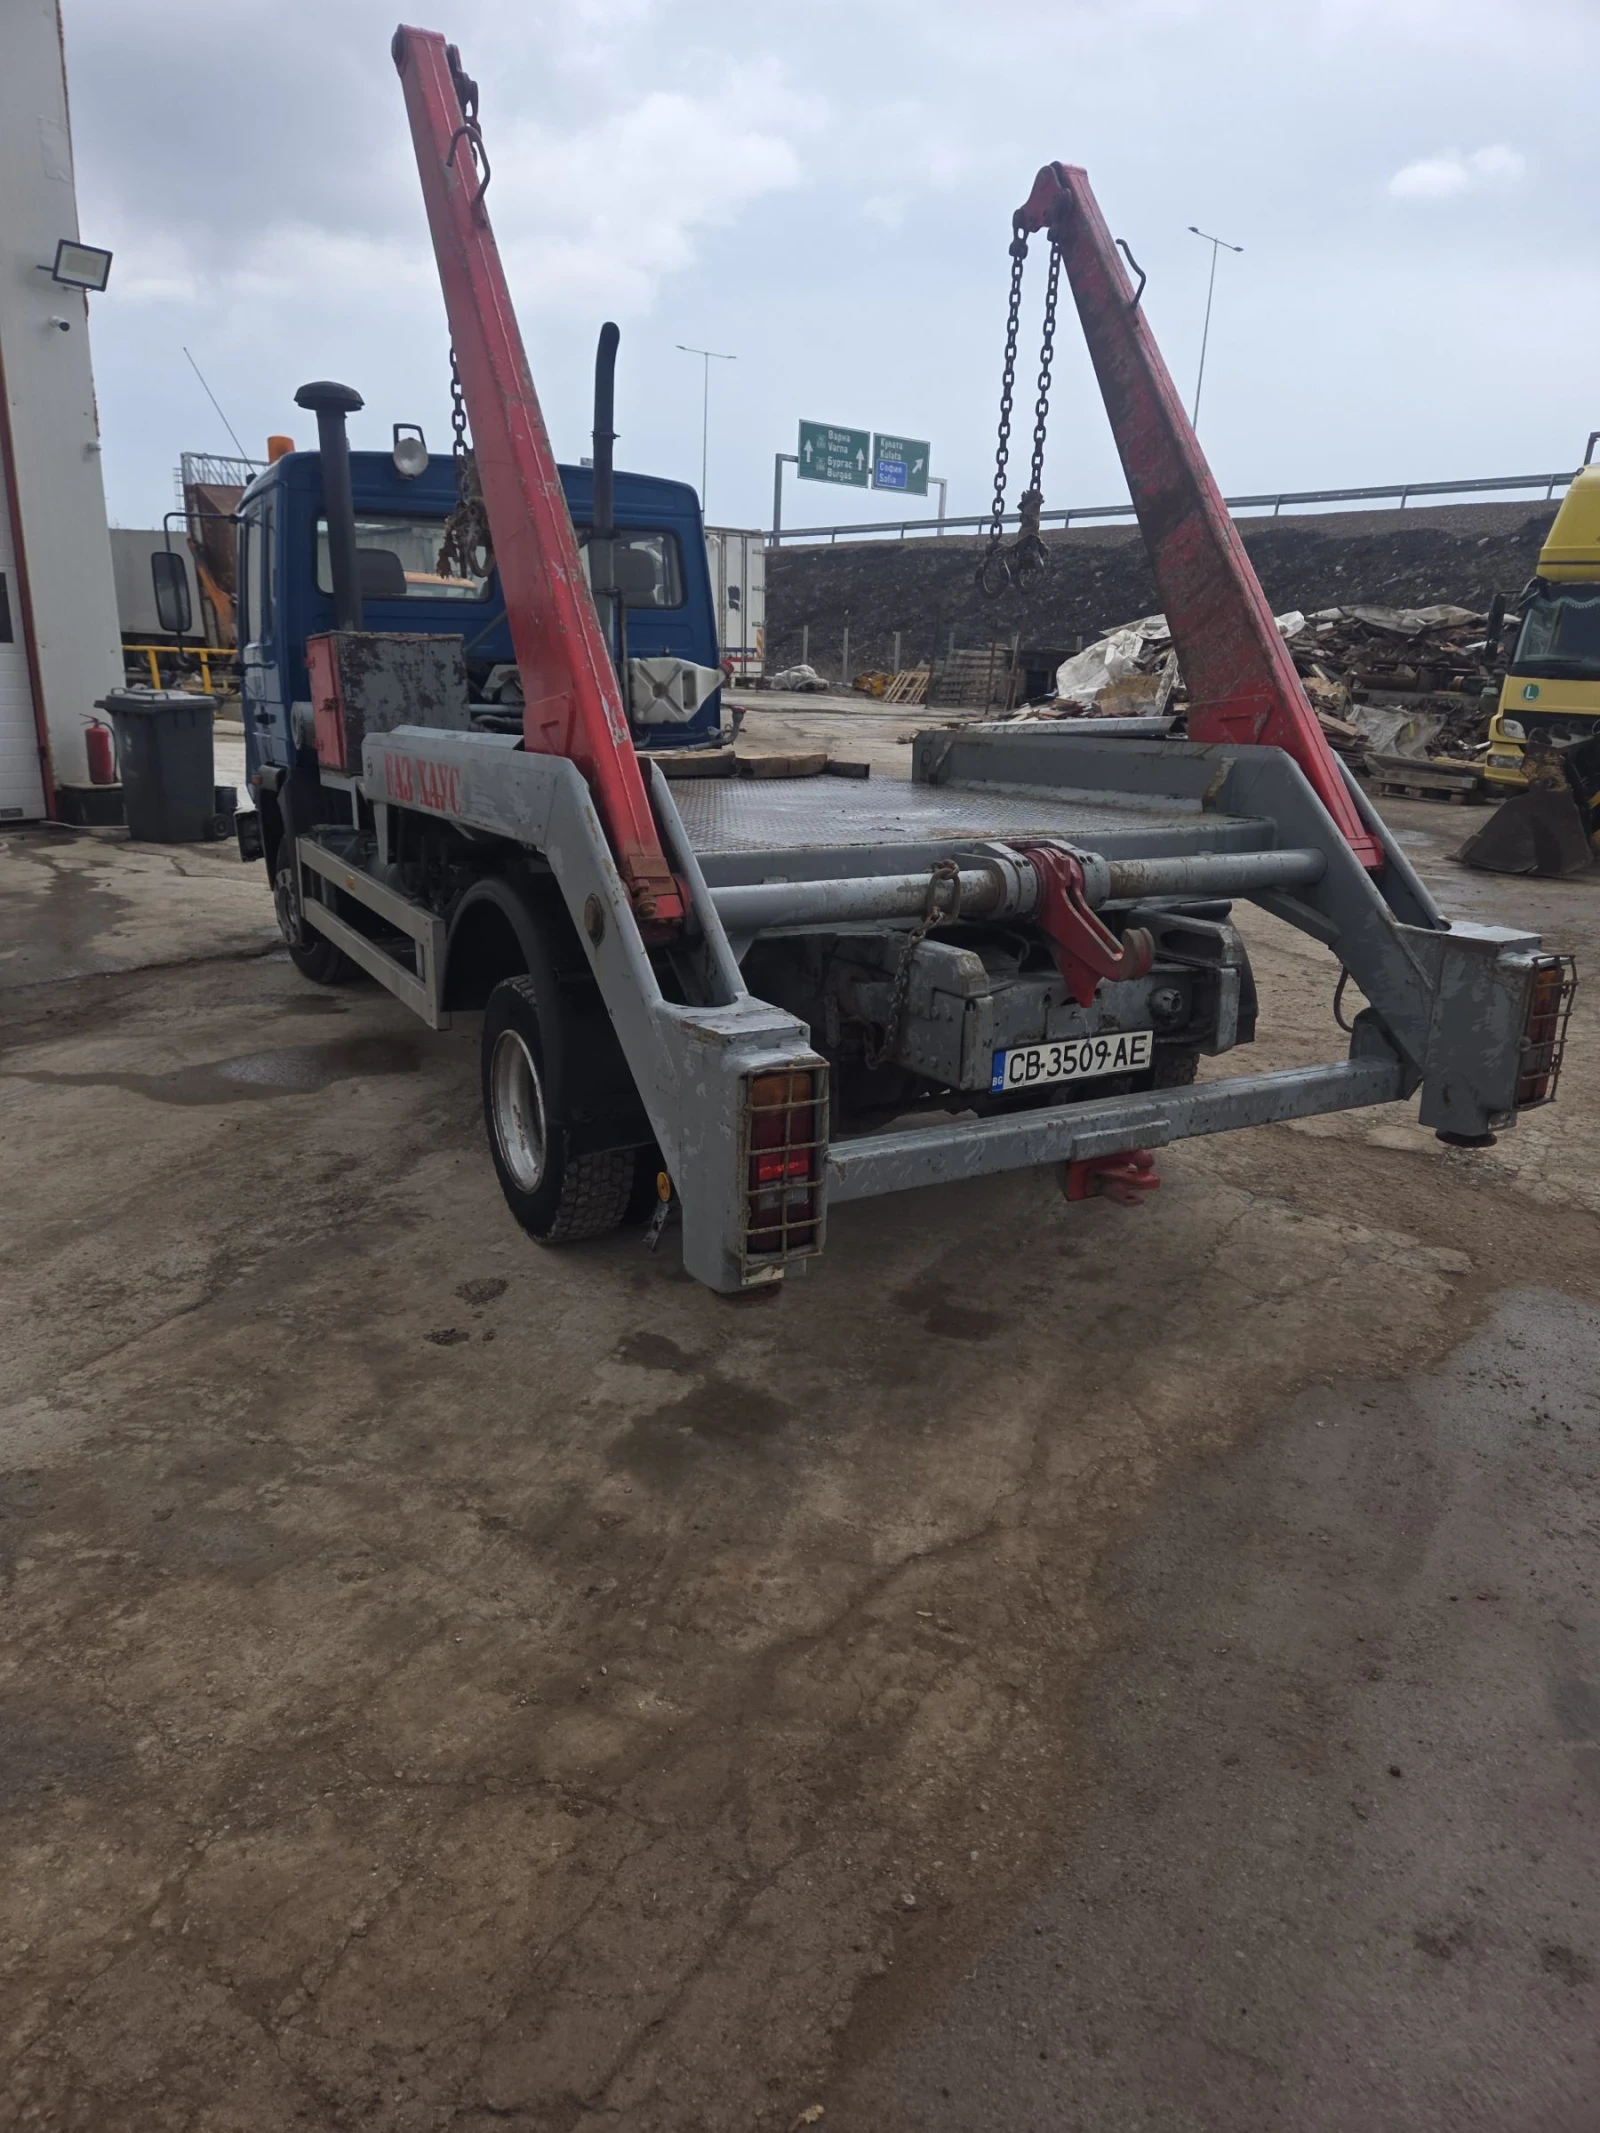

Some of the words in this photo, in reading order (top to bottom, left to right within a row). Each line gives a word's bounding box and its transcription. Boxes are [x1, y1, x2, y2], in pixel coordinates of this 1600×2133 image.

[828, 430, 850, 443] Варна
[828, 441, 848, 453] Varna
[880, 438, 903, 449] Кулата
[880, 450, 901, 460] Kulata
[827, 456, 852, 468] Бургас
[827, 467, 852, 481] Burgas
[879, 474, 897, 484] Sofia
[992, 1076, 1003, 1087] BG
